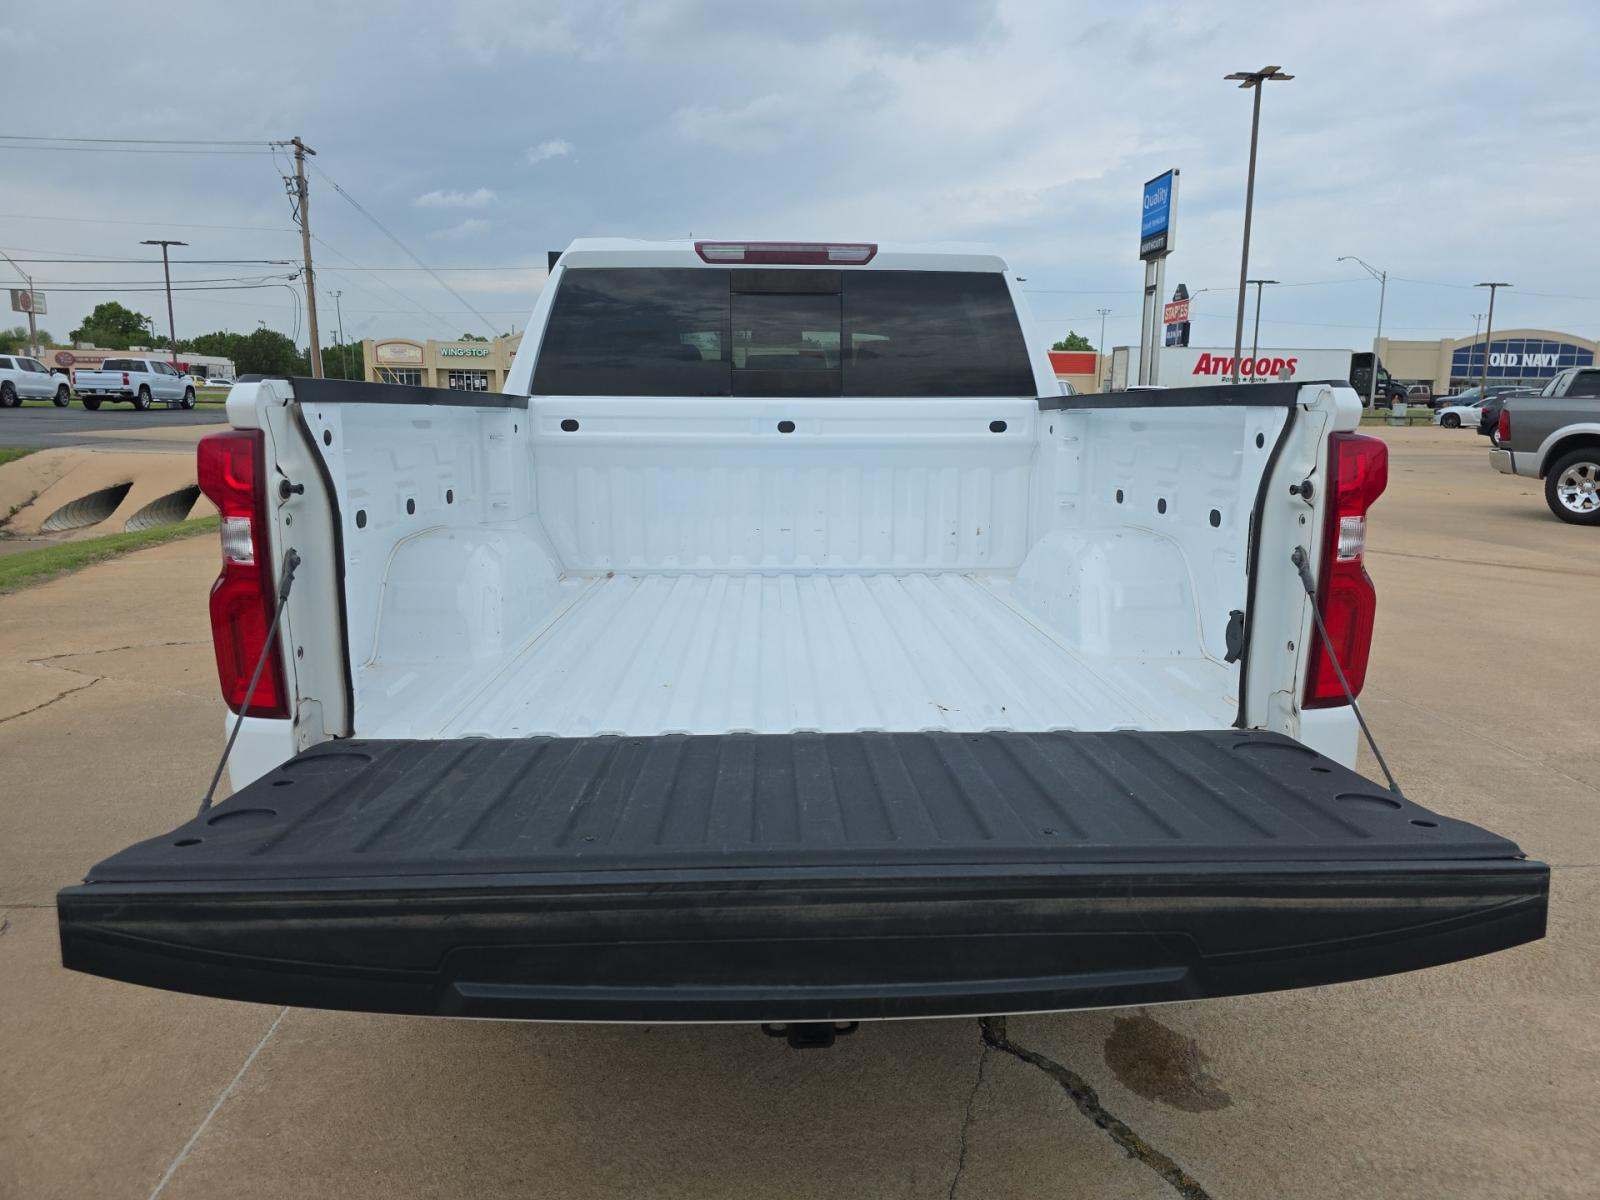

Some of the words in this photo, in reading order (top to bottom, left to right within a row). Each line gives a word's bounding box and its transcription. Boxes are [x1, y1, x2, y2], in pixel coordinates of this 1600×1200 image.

[1144, 187, 1168, 208] Quality
[1165, 304, 1188, 320] STAPLES
[1489, 353, 1518, 367] OLD
[1522, 353, 1560, 368] NAVY
